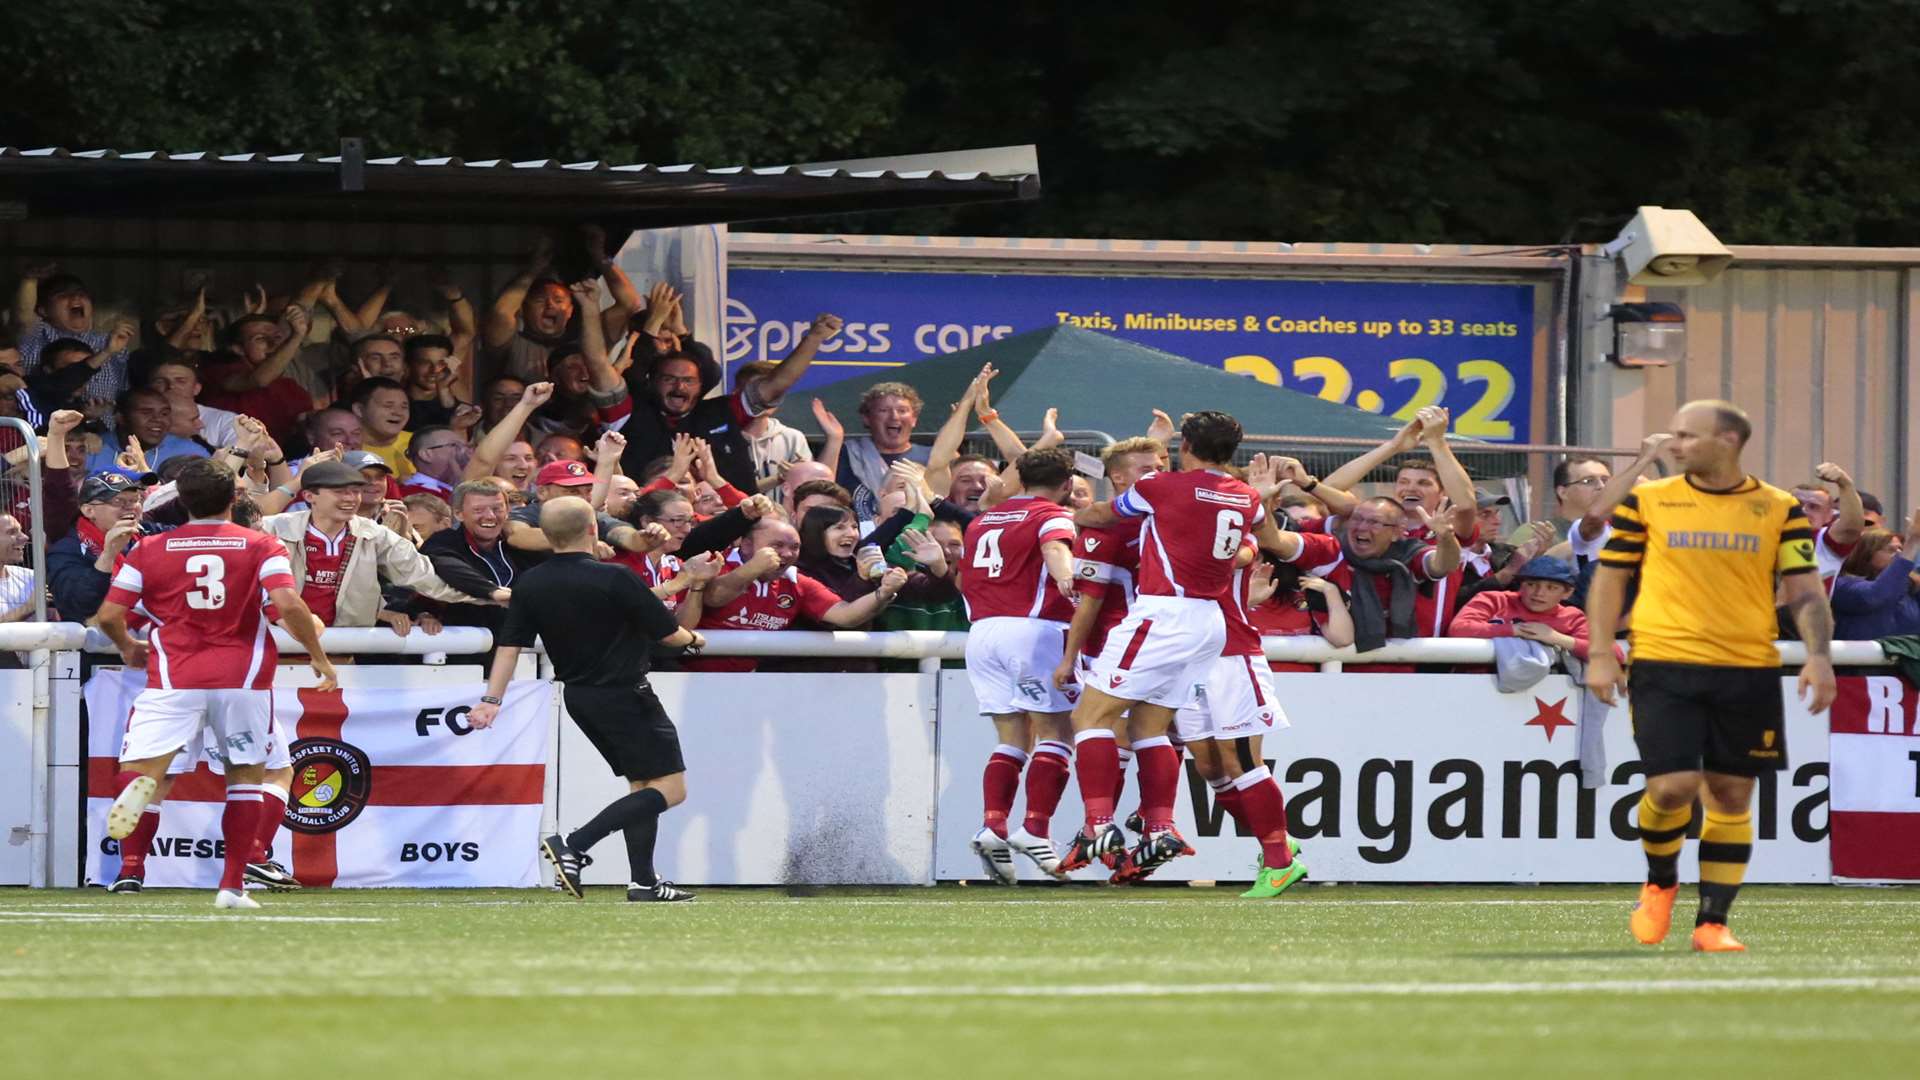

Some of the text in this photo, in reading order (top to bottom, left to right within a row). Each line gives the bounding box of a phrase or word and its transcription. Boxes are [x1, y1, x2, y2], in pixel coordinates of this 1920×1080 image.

[915, 323, 1013, 354] cars
[1056, 312, 1517, 338] Taxis, Minibuses & Coaches up to 33 seats
[1212, 509, 1244, 560] 6
[1668, 531, 1761, 553] BRITELITE
[973, 528, 1005, 578] 4
[185, 554, 226, 610] 3
[415, 705, 475, 737] FC
[335, 748, 360, 775] UNITED
[284, 805, 350, 825] OOTBALL CLUB
[400, 842, 480, 862] BOYS
